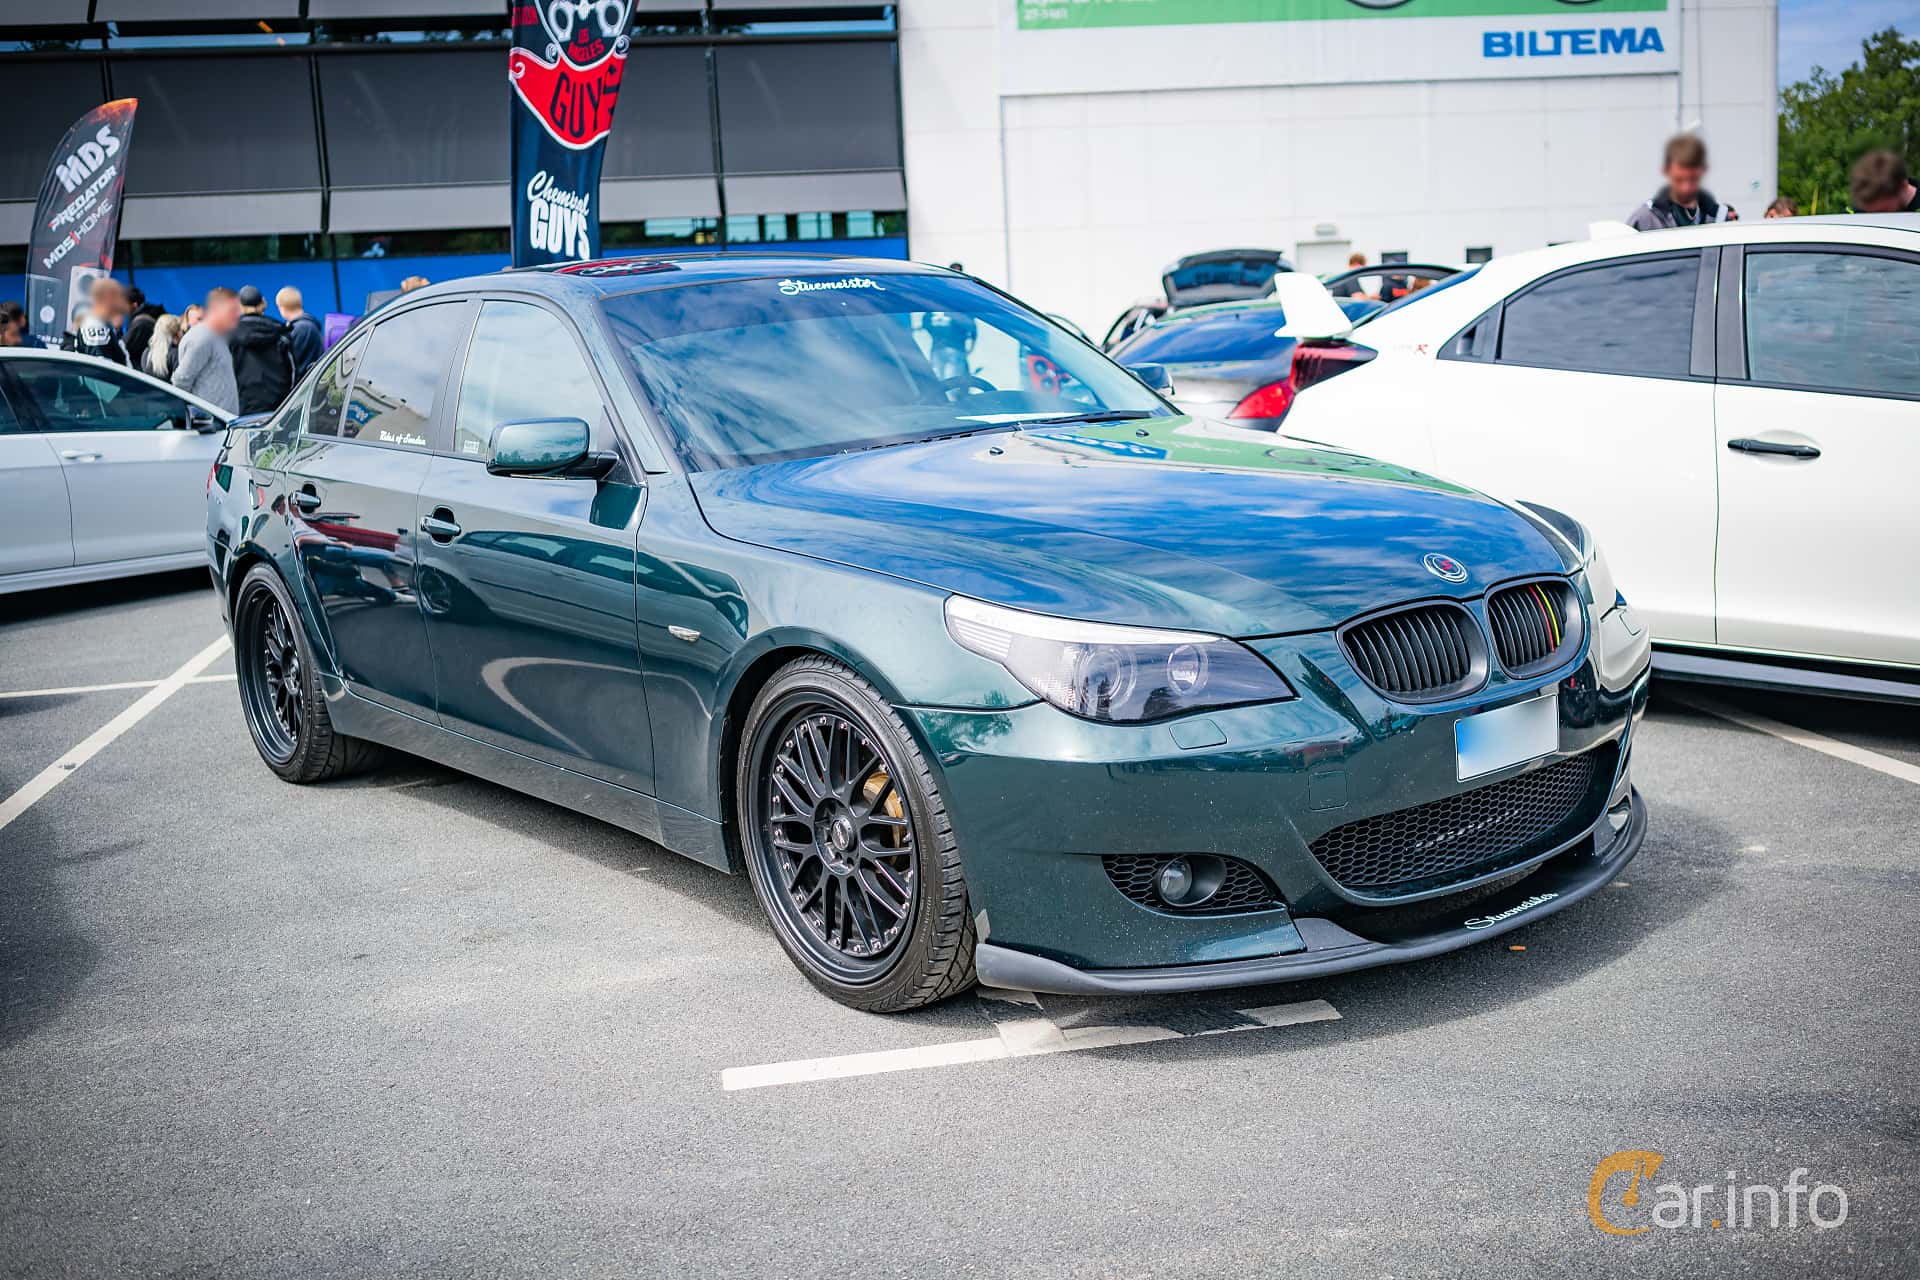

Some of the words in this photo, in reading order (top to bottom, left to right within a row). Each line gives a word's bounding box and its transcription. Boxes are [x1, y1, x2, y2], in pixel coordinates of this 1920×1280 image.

[1483, 27, 1665, 58] BILTEMA
[55, 124, 121, 194] MDS
[47, 165, 118, 232] PREDATOR
[526, 170, 590, 216] Chemical
[529, 198, 591, 261] GUYS
[395, 433, 403, 445] of
